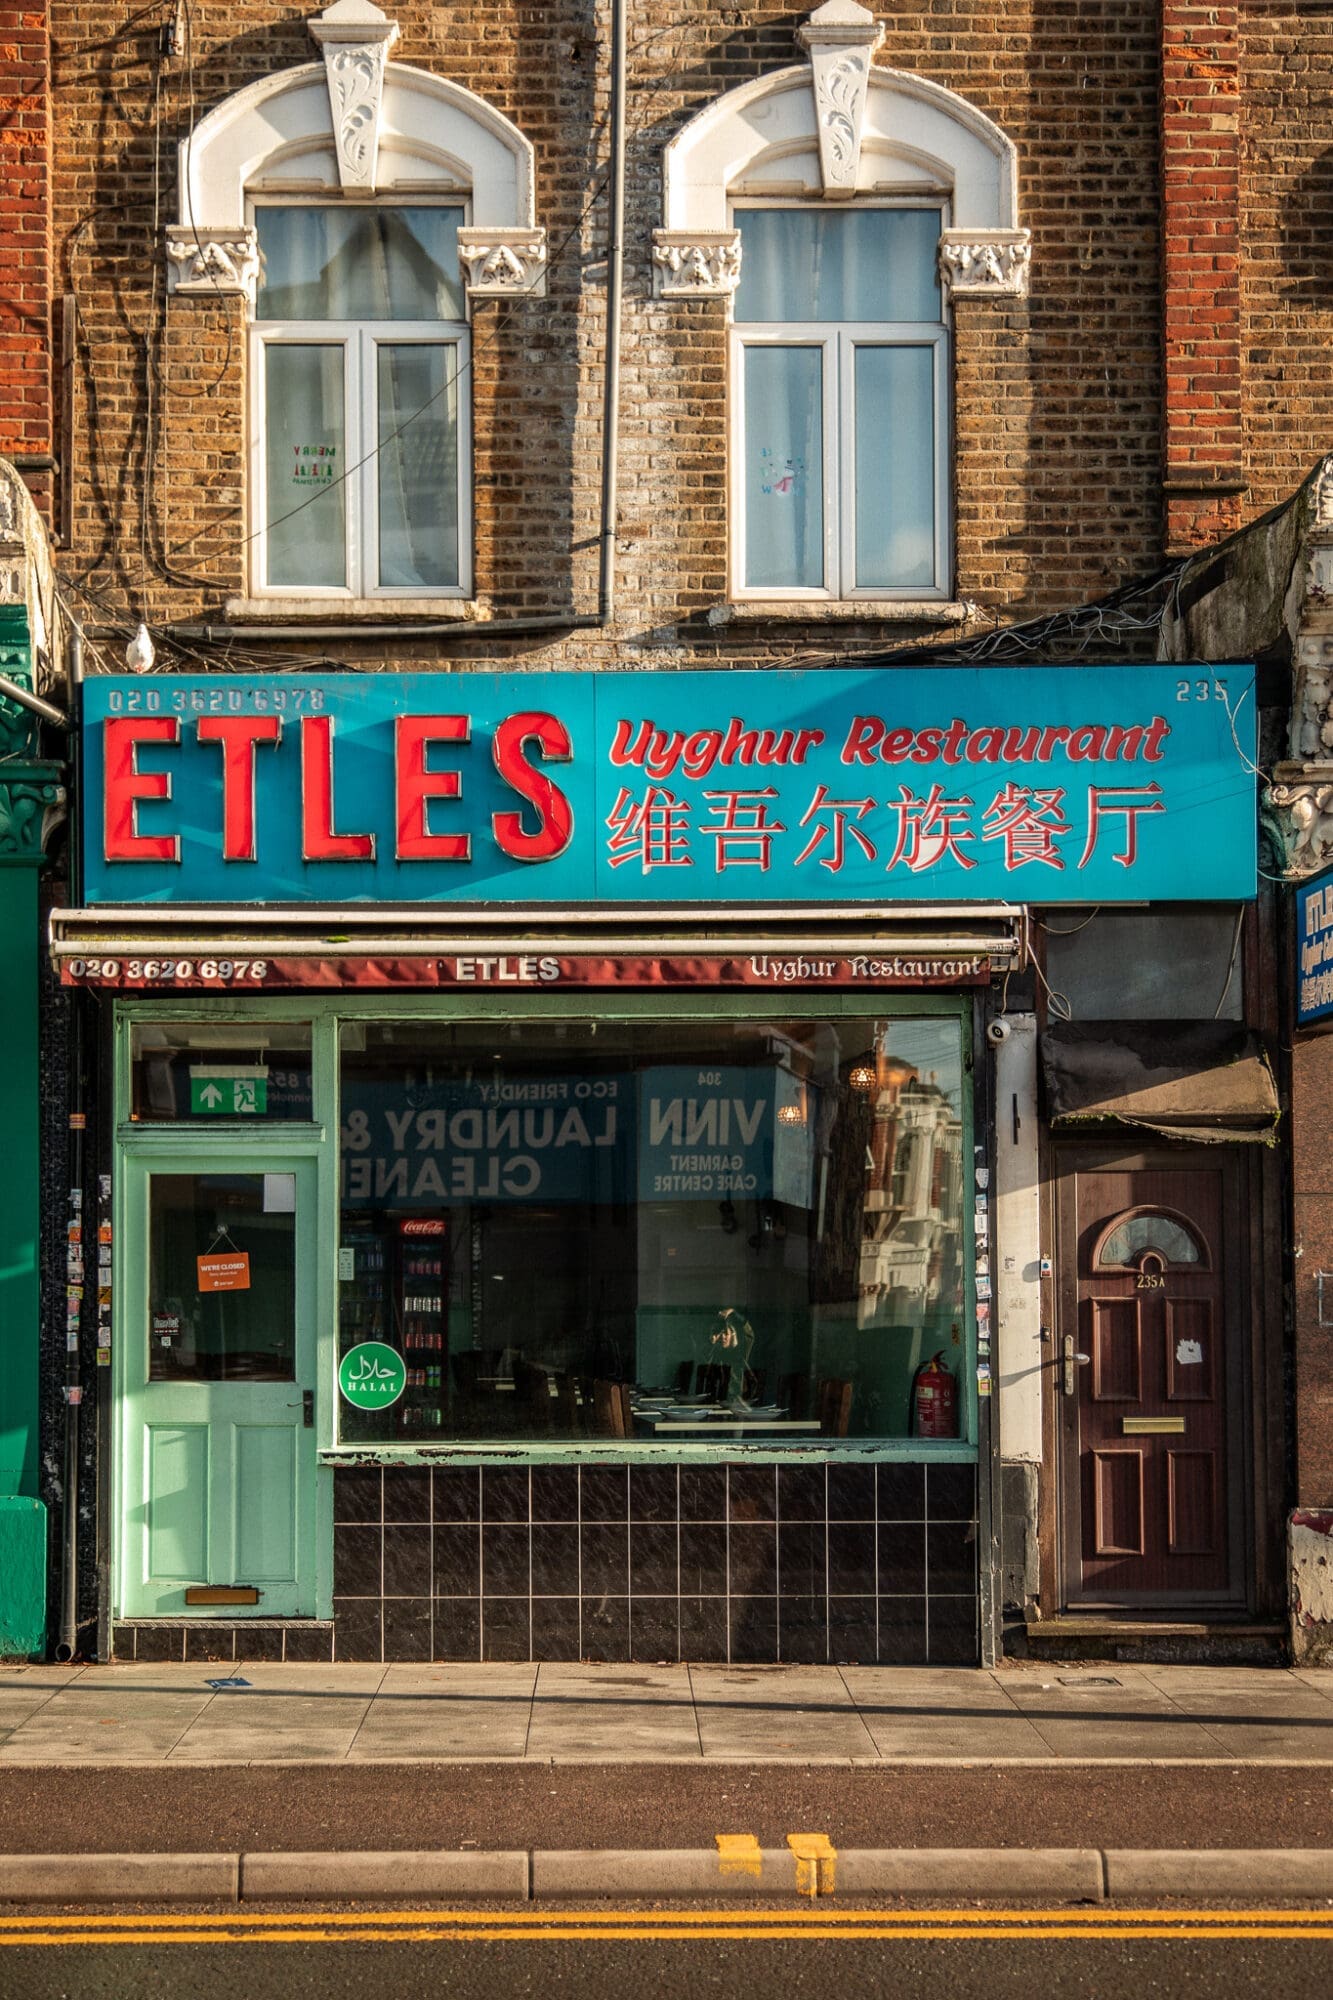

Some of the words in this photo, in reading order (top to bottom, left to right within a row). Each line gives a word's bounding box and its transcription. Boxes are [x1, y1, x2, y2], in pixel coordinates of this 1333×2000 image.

[108, 689, 161, 711] 020
[172, 689, 242, 711] 3620
[254, 689, 325, 711] 6978
[1176, 681, 1228, 701] 235
[608, 716, 824, 779] Uyghur
[841, 716, 1170, 765] Restaurant
[103, 711, 573, 863] ETLES
[604, 782, 1167, 874] 维吾尔族餐厅
[69, 959, 120, 979] 020
[127, 959, 194, 979] 3620
[200, 959, 268, 979] 6978
[456, 957, 560, 981] ETLES
[750, 955, 836, 982] Uyghur
[848, 955, 982, 977] Restaurant
[220, 1262, 246, 1270] CLOSED
[348, 1355, 397, 1380] حلال
[347, 1382, 397, 1392] HALAL
